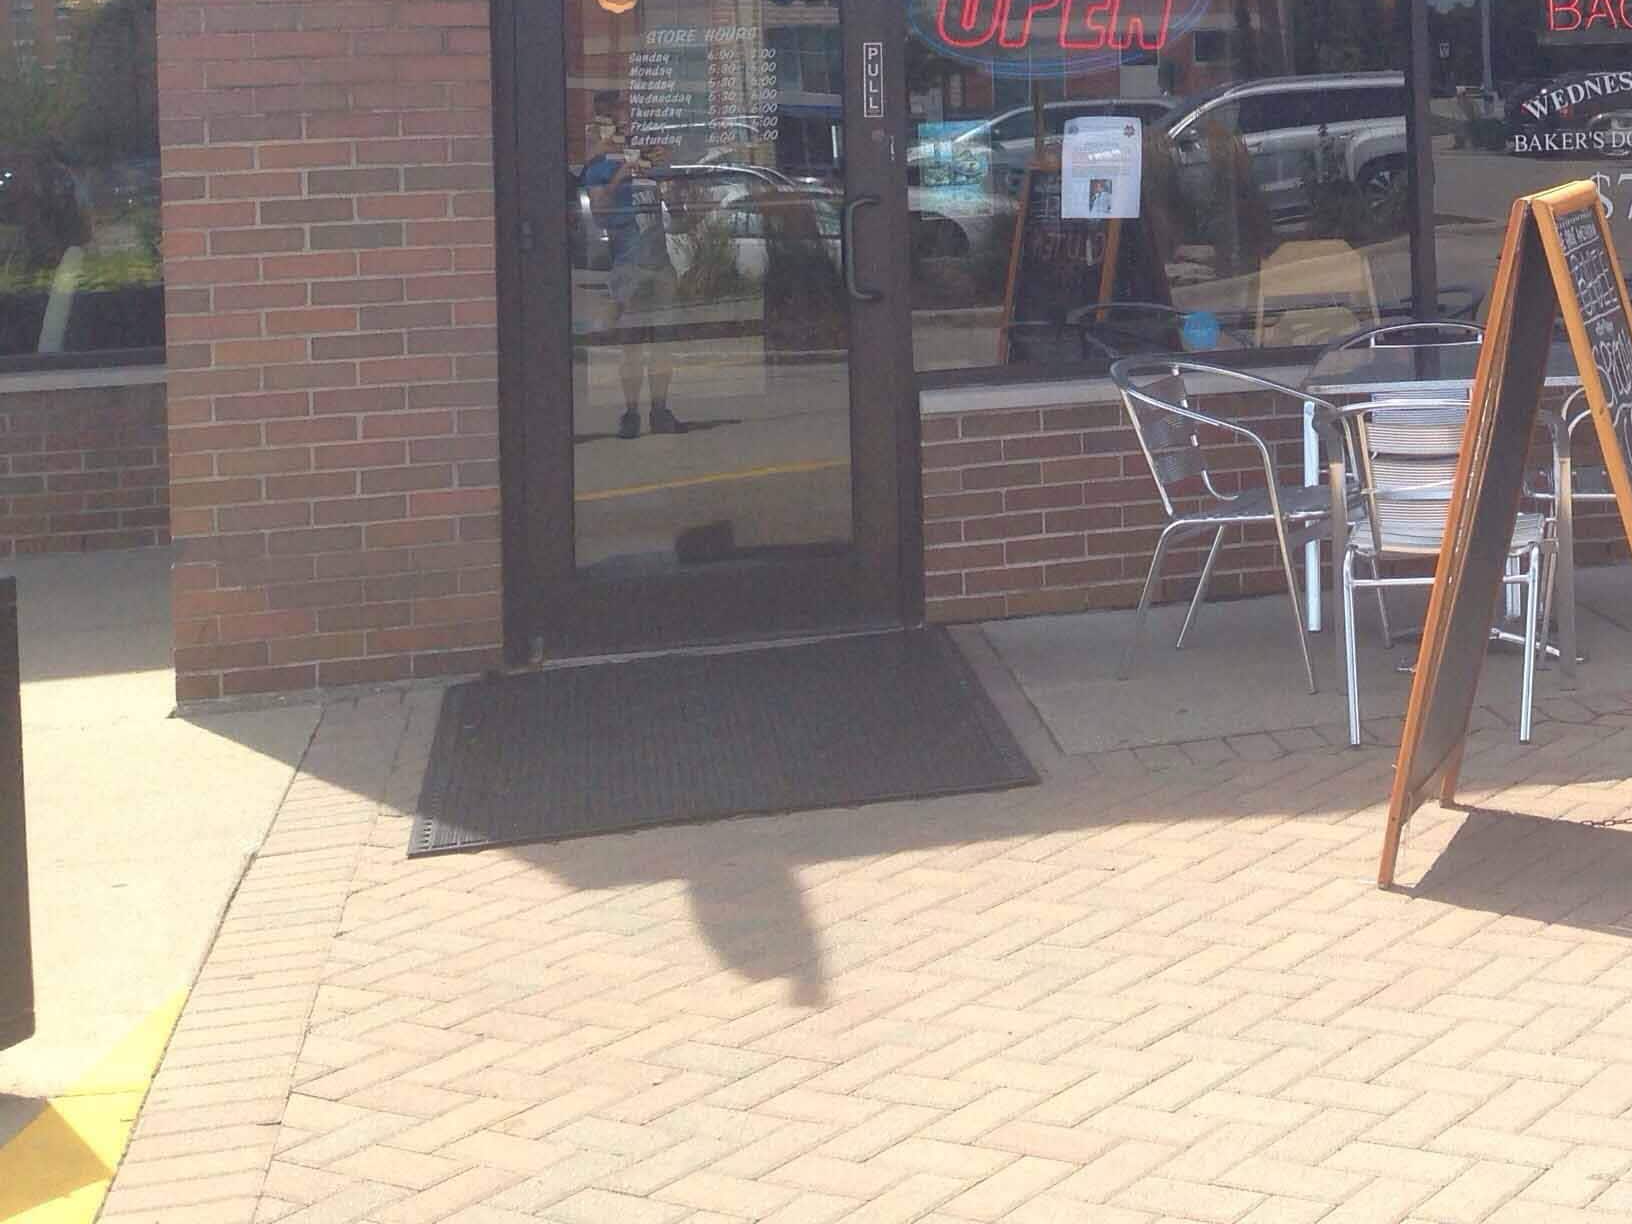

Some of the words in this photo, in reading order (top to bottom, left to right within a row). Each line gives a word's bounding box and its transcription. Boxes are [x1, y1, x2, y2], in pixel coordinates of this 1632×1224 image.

[645, 28, 697, 45] STORE
[867, 46, 880, 109] PULL
[1513, 130, 1605, 153] BAKER'S
